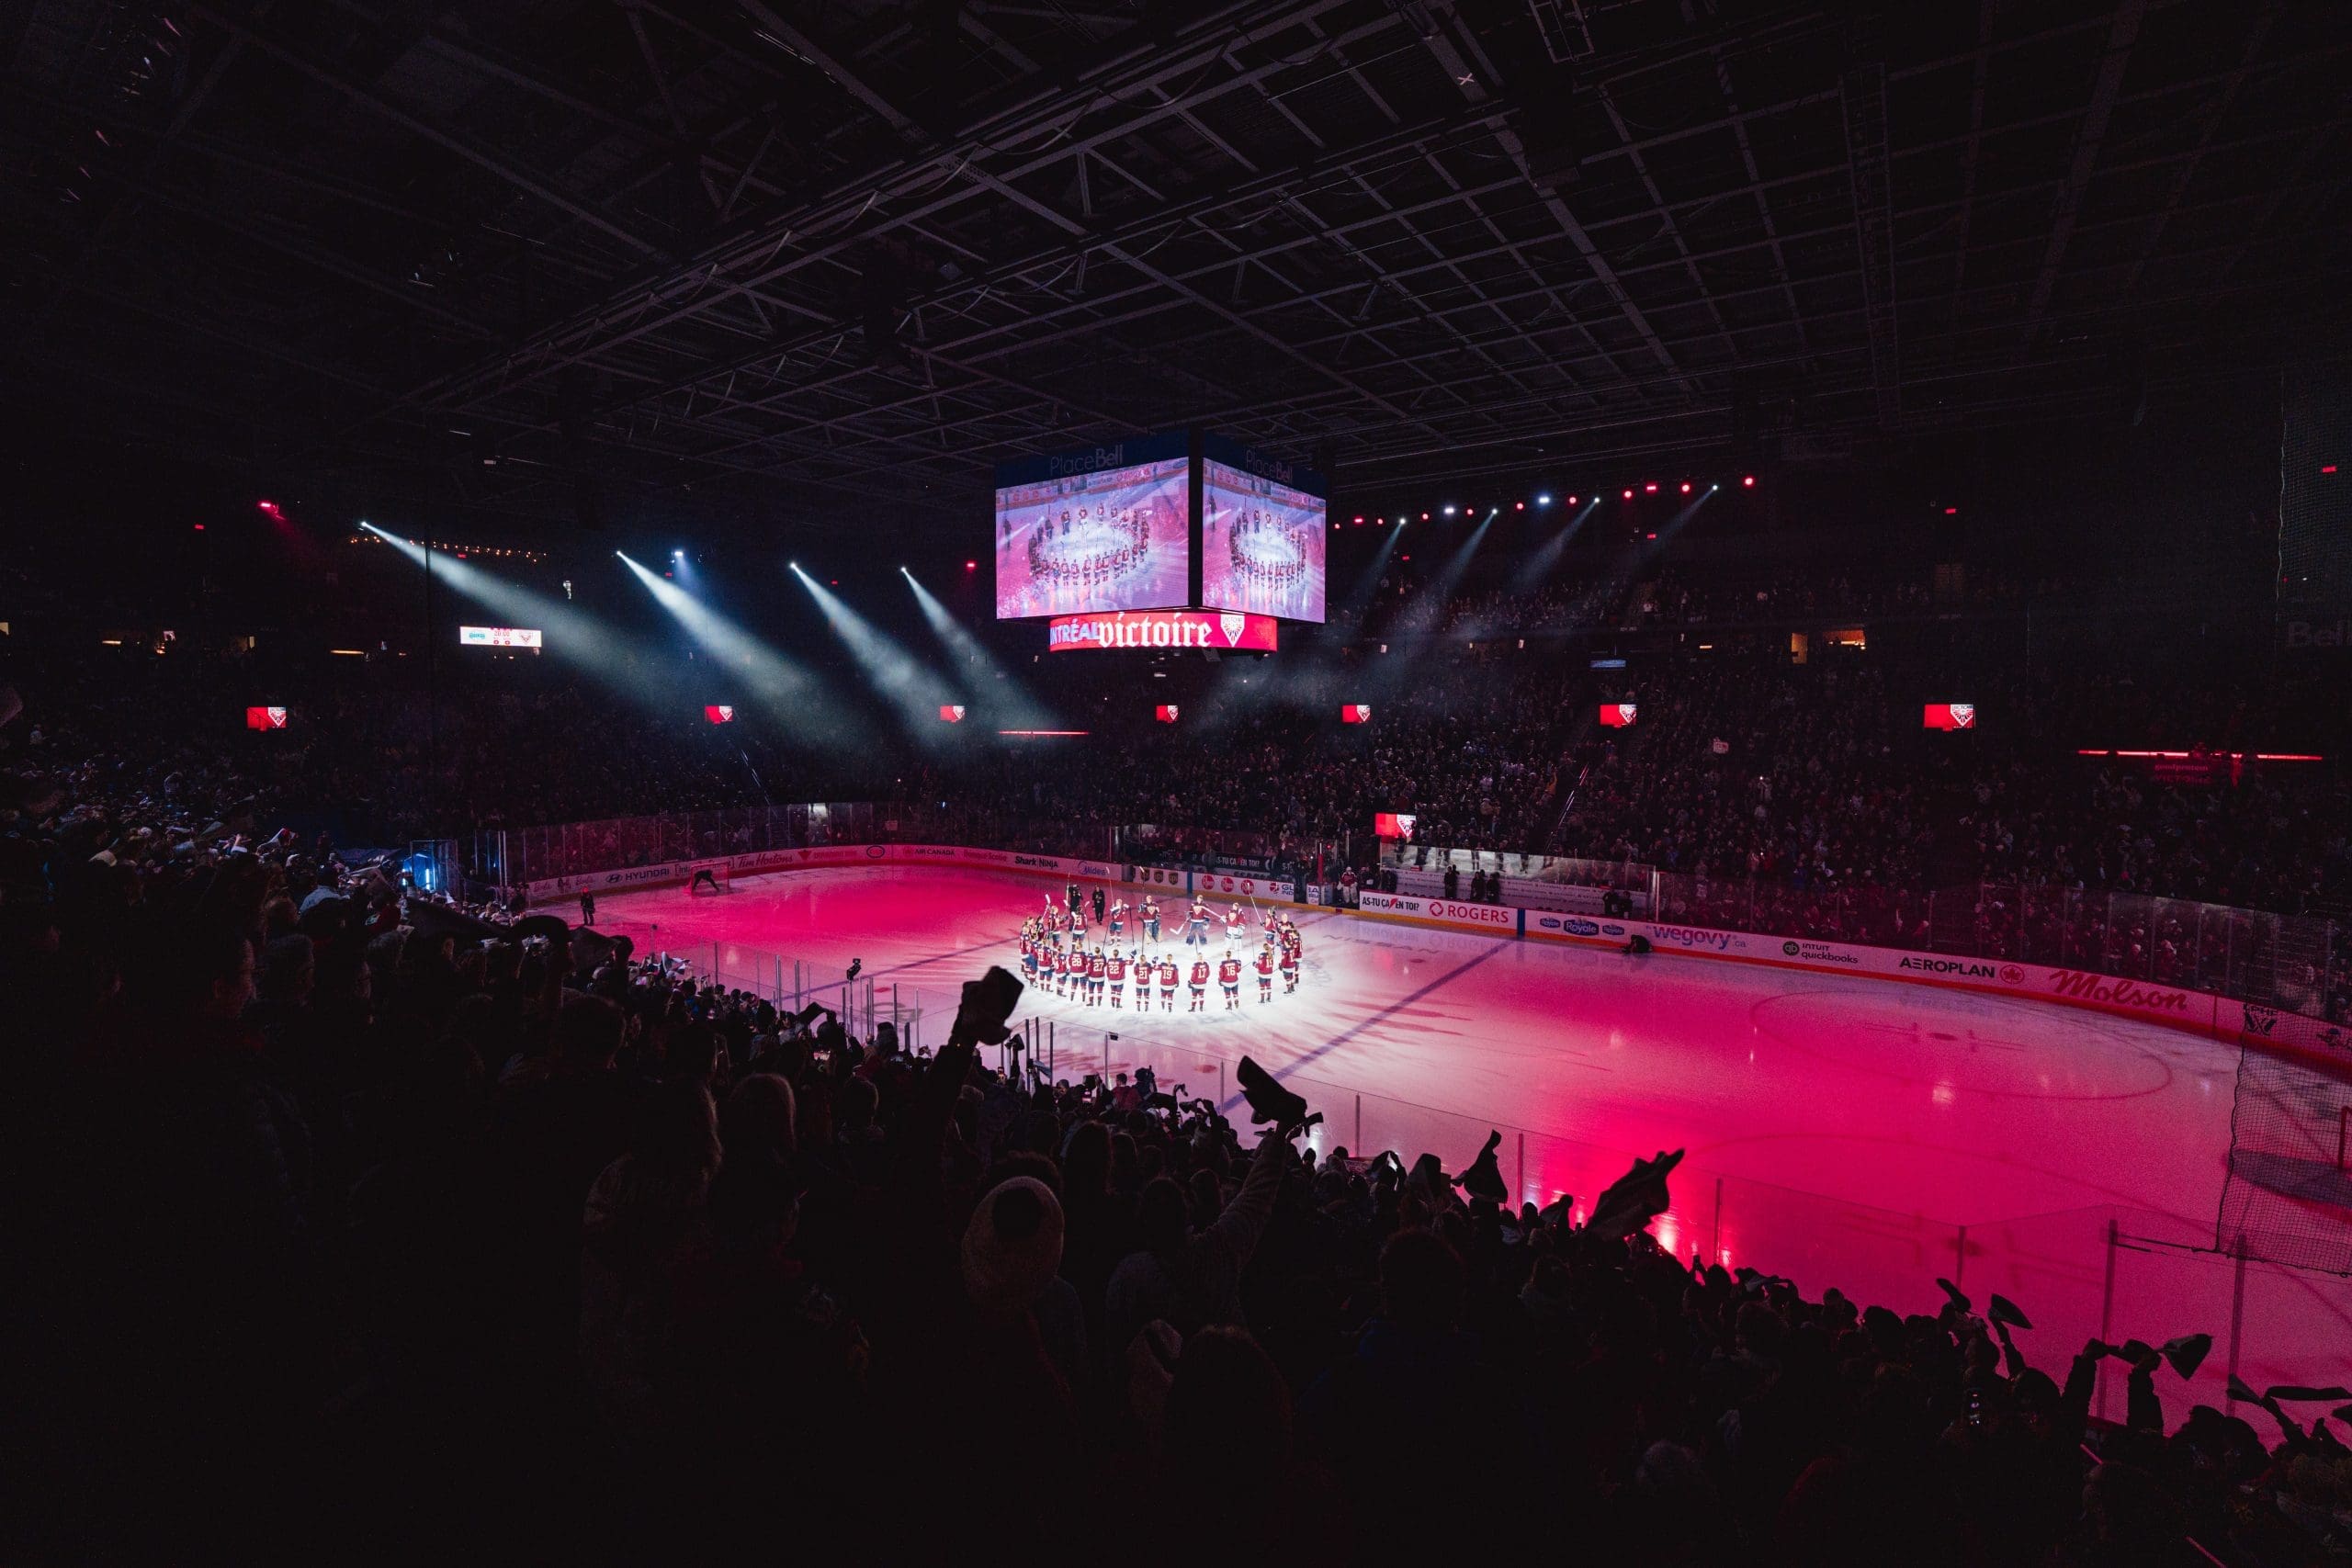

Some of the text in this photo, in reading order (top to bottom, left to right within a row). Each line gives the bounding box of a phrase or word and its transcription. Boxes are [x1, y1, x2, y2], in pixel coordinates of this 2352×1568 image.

[738, 852, 794, 868] Tim Hortons
[1015, 855, 1036, 866] Shark
[626, 868, 670, 881] HYUNDAI
[1362, 896, 1380, 907] AS-TU
[1396, 900, 1404, 909] EN
[1405, 901, 1419, 911] TOI?
[1448, 905, 1510, 923] ROGERS
[1566, 920, 1598, 934] Royale
[1071, 957, 1082, 967] 28
[1802, 952, 1859, 964] quickbooks
[1093, 962, 1104, 972] 27
[1108, 964, 1120, 975] 22
[1227, 965, 1236, 976] 16
[1899, 956, 1996, 978] AEROPLAN
[1138, 970, 1148, 979] 21
[1163, 970, 1172, 979] 19
[1197, 968, 1206, 979] 17
[2049, 969, 2188, 1010] Molson
